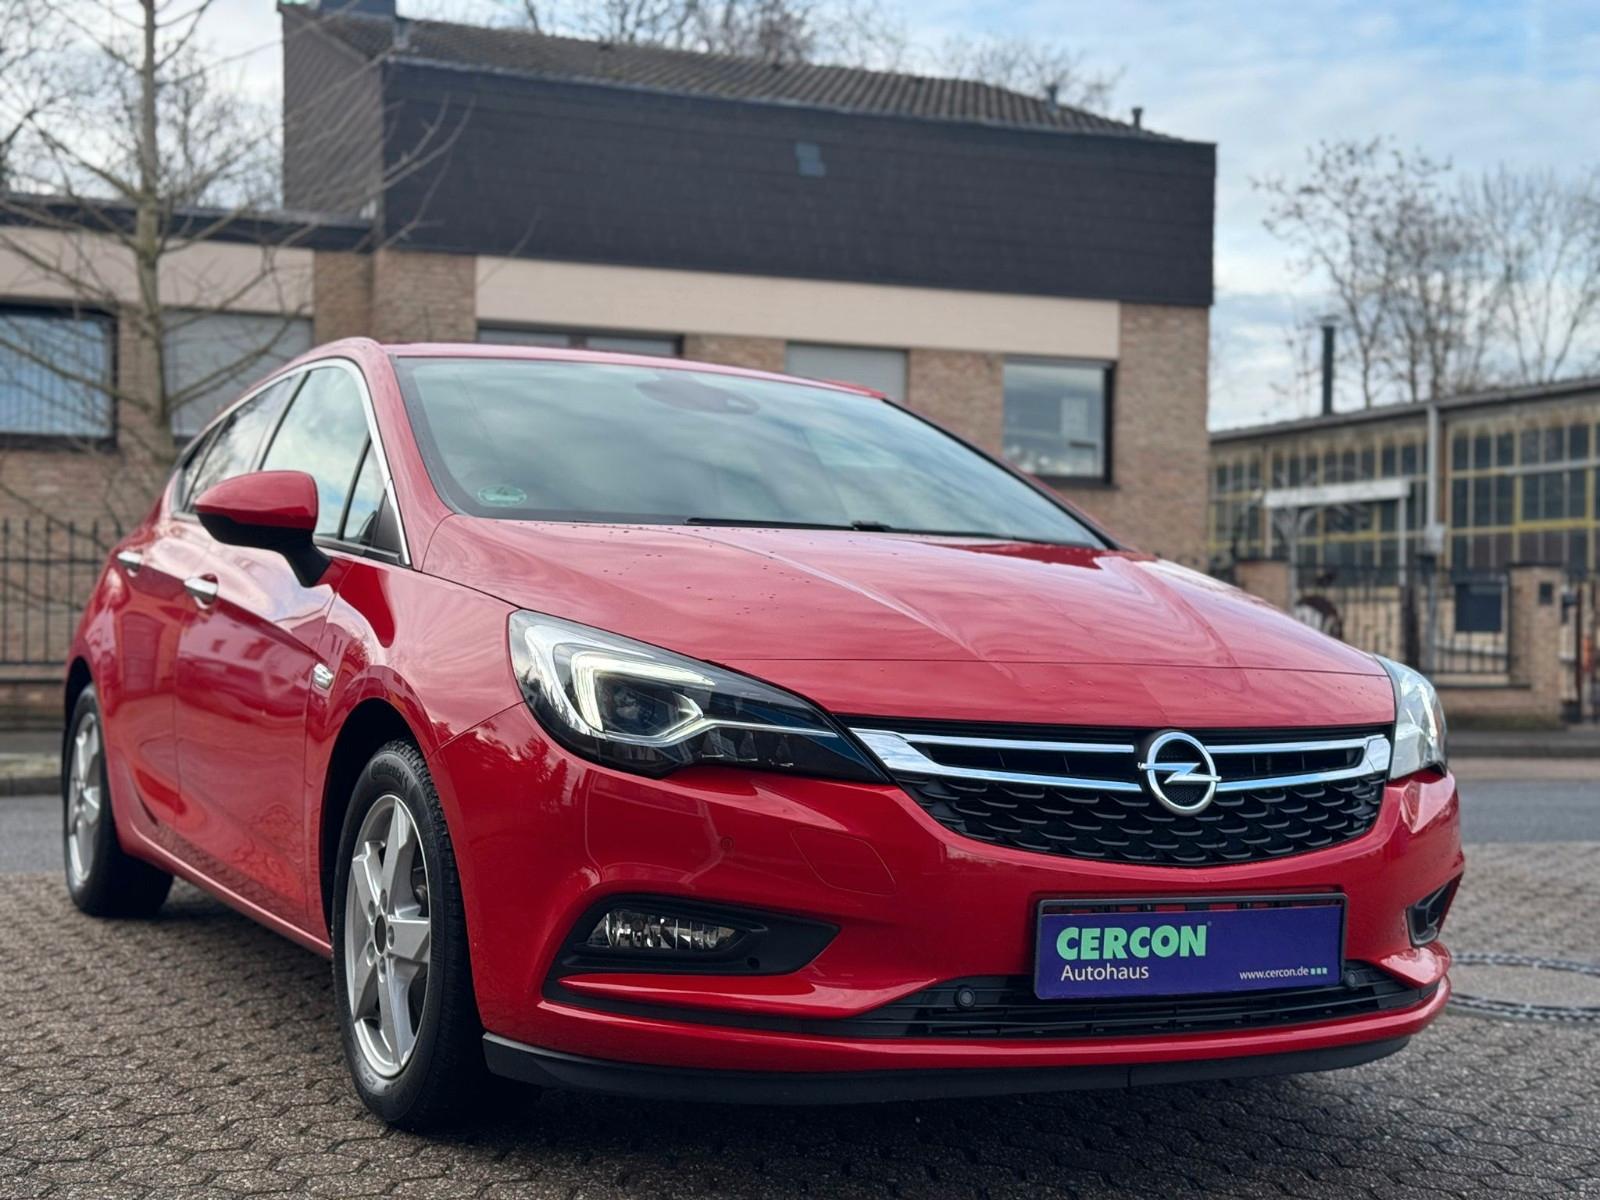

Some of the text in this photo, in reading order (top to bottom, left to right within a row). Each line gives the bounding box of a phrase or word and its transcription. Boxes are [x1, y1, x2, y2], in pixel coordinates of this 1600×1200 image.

[1056, 925, 1207, 960] CERCON
[1061, 963, 1149, 981] Autohaus
[1240, 966, 1309, 980] www.cercon.de
